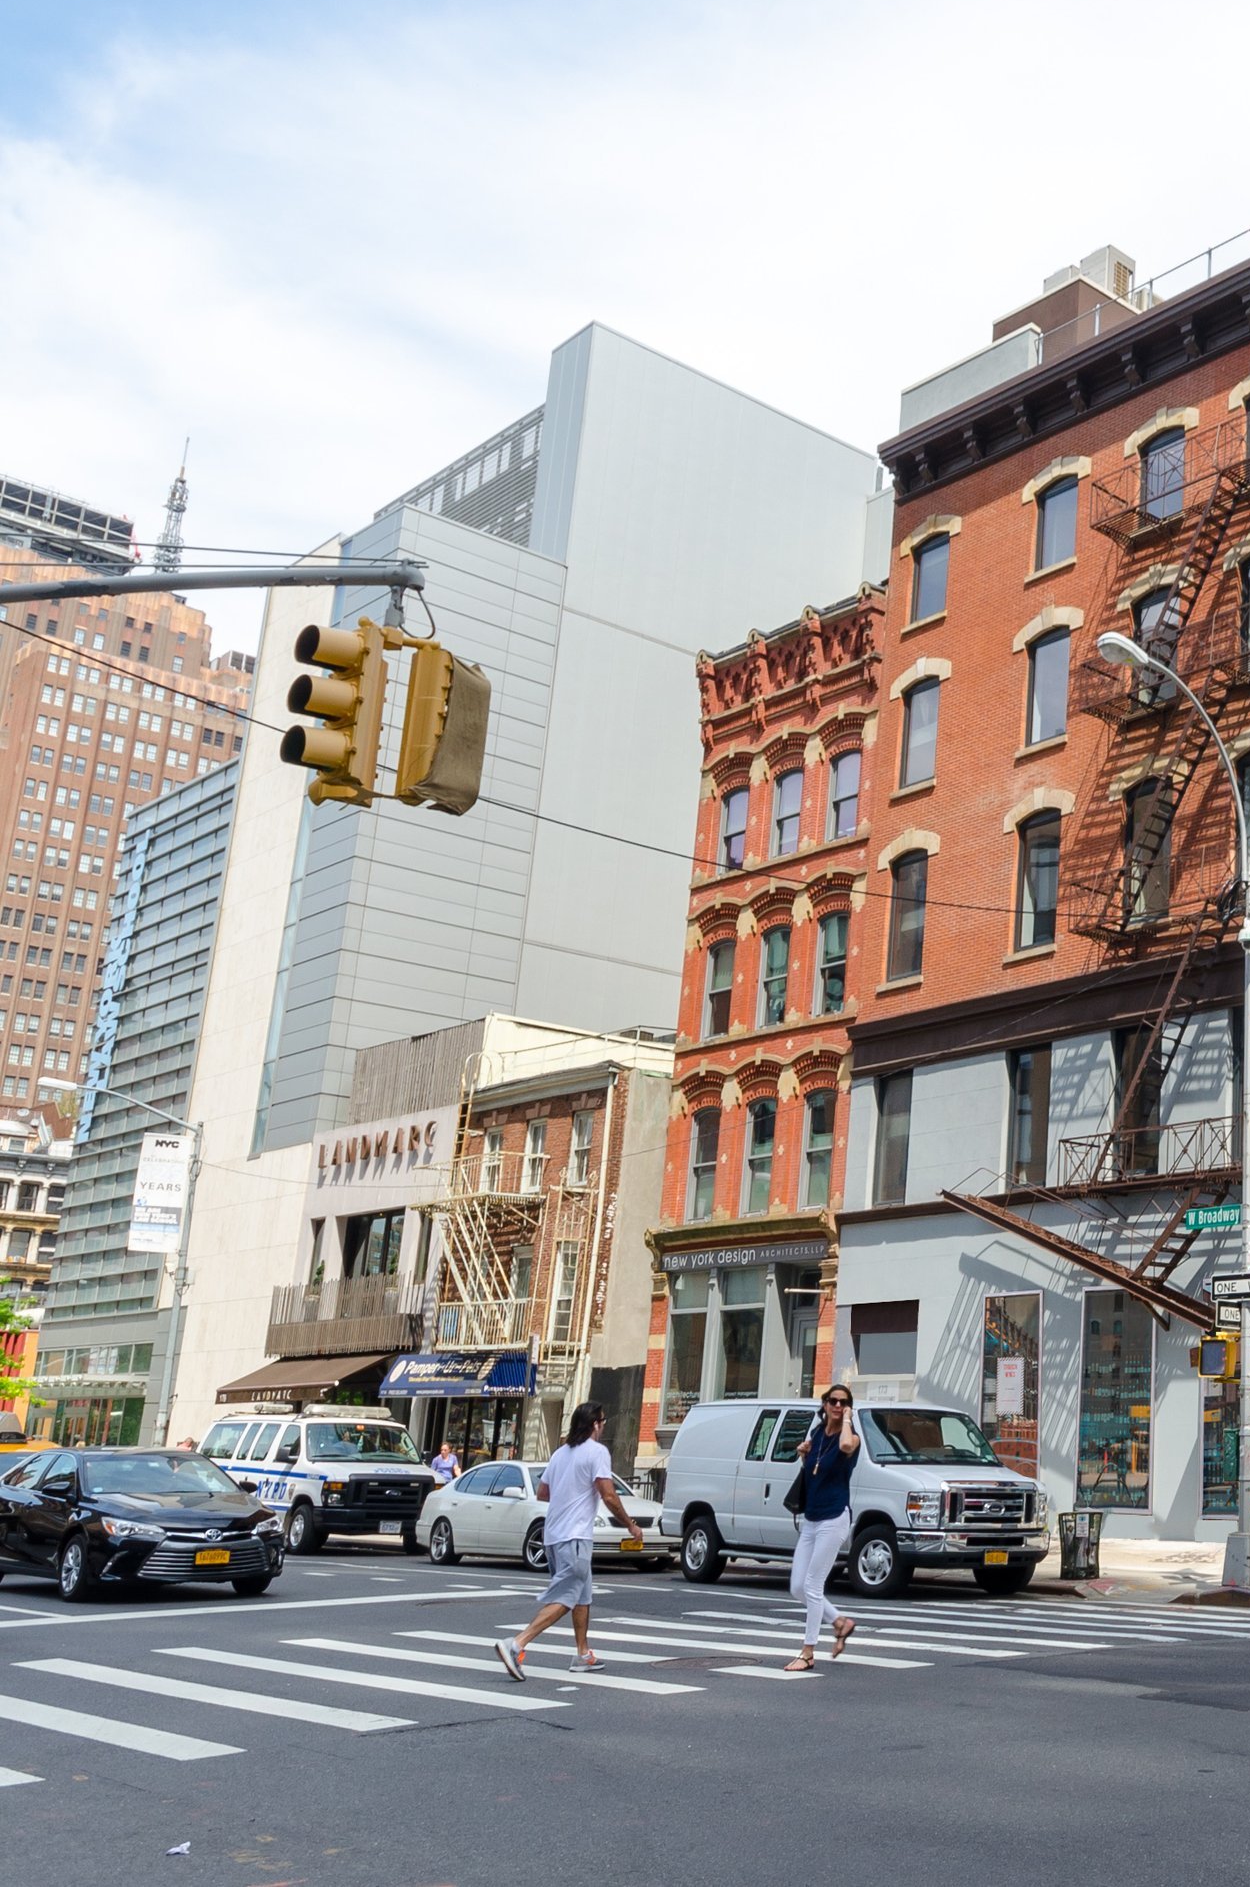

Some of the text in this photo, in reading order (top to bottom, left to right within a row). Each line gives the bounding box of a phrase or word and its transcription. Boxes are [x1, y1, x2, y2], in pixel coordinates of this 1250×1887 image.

[95, 829, 150, 1091] LAW SCHOOL
[75, 937, 123, 1144] NEW YORK
[155, 1139, 180, 1149] NYC
[318, 1120, 437, 1169] LANDMARC
[140, 1181, 182, 1192] YEARS
[1188, 1208, 1240, 1225] W Broadway
[664, 1255, 687, 1268] new
[691, 1251, 714, 1268] york
[717, 1248, 756, 1265] design
[1216, 1282, 1237, 1293] ONE
[1224, 1309, 1239, 1320] ONE
[256, 1479, 287, 1500] NYPD
